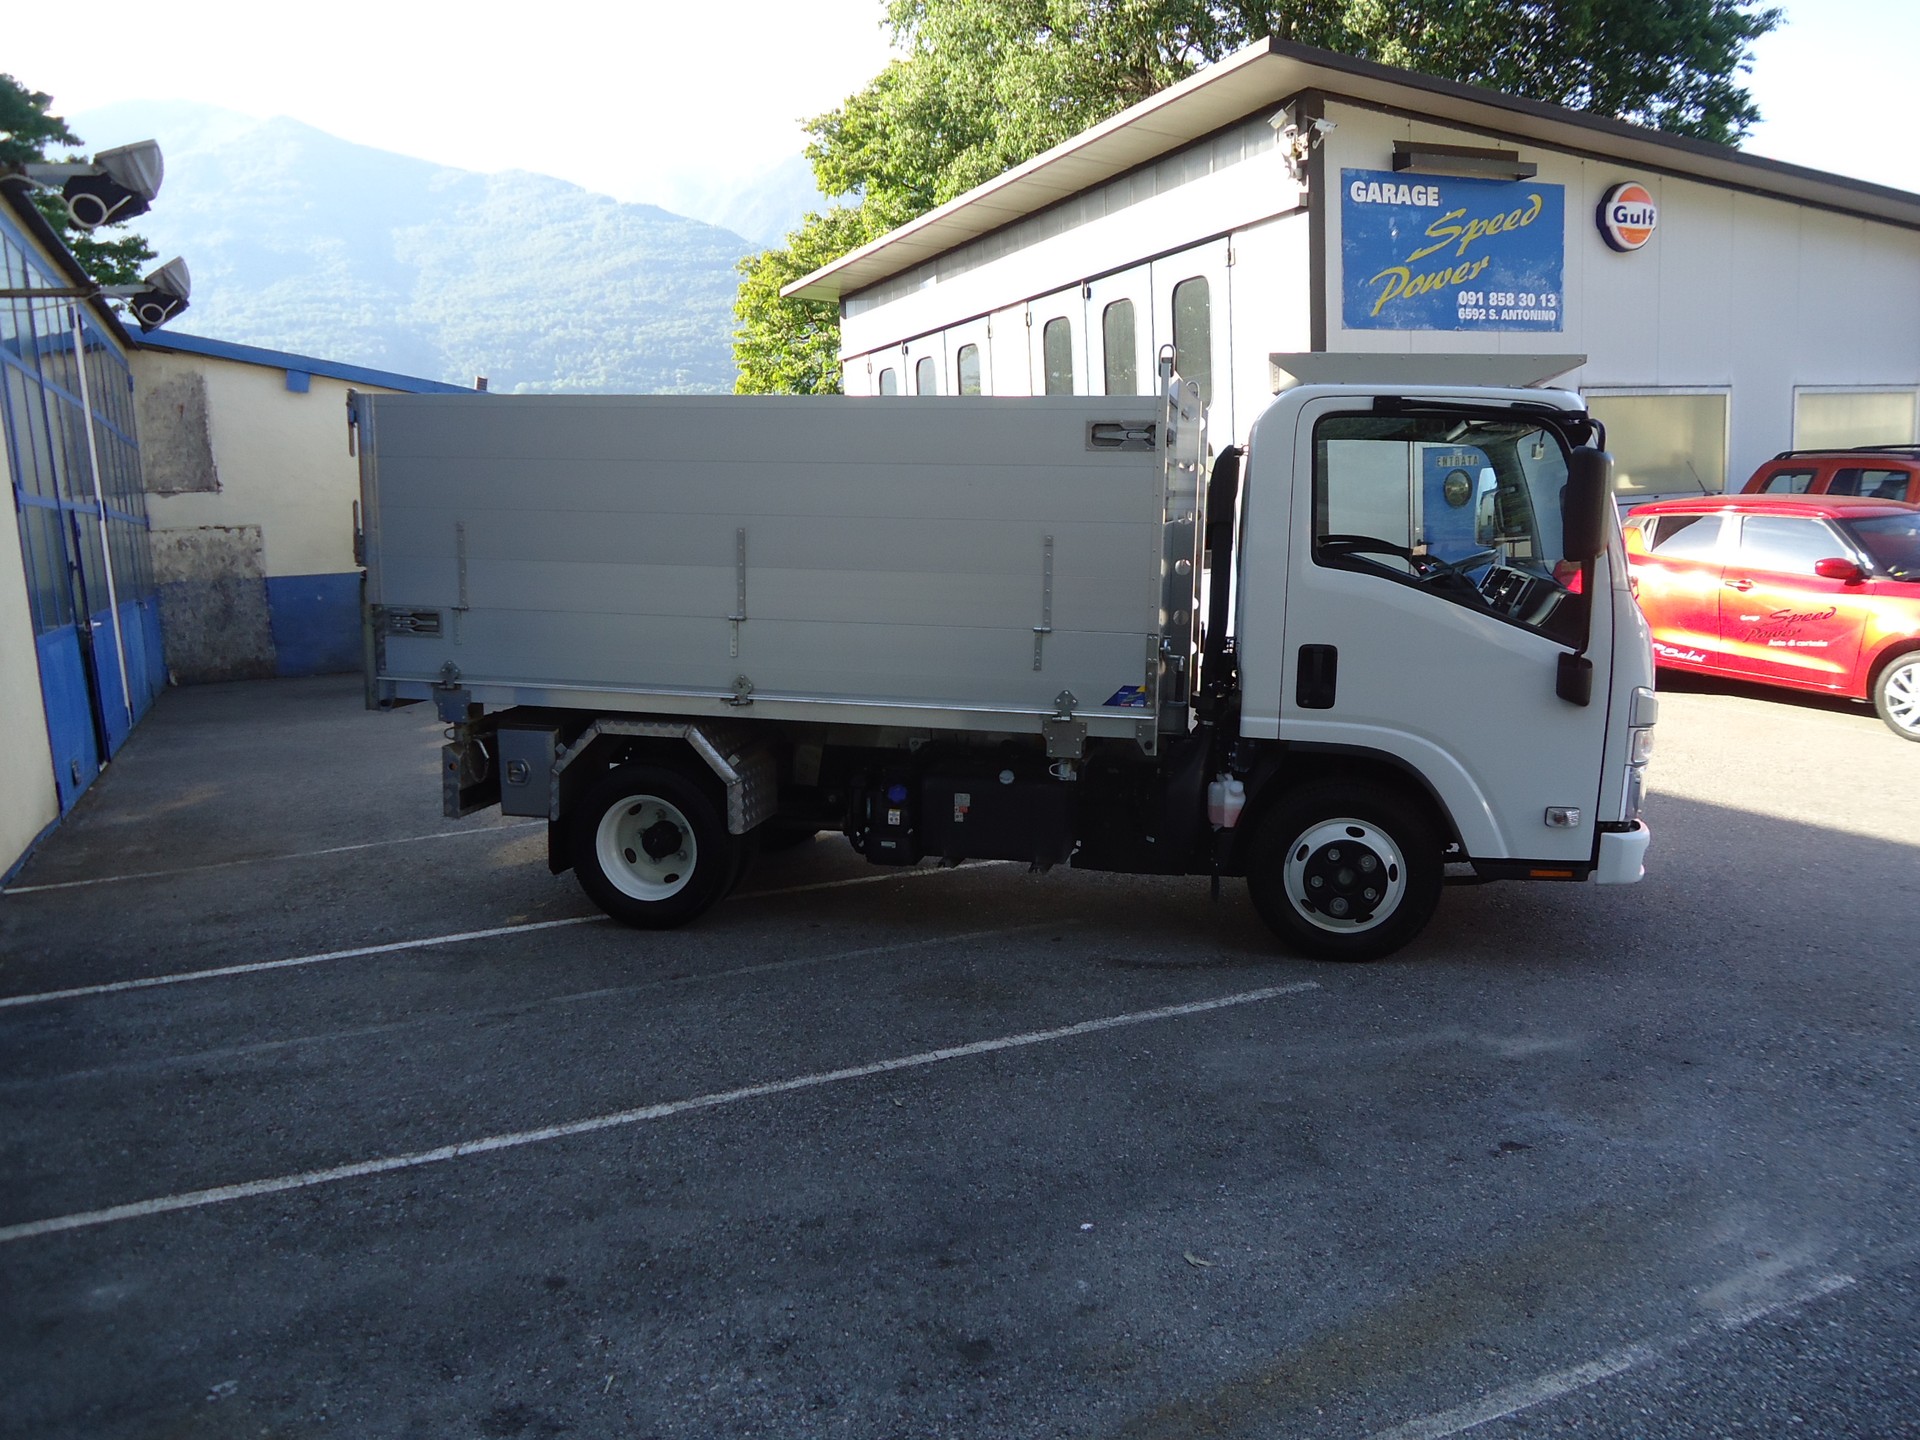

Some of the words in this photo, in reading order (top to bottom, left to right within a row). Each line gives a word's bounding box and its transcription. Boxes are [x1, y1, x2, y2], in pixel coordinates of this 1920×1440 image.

[1350, 181, 1439, 206] GARAGE
[1613, 205, 1655, 225] Gulf
[1405, 194, 1543, 262] Speed
[1369, 255, 1490, 317] Power
[1458, 291, 1484, 305] 091
[1489, 292, 1515, 306] 858
[1518, 293, 1535, 307] 30
[1540, 294, 1556, 307] 13
[1458, 308, 1486, 320] 6592
[1489, 308, 1499, 320] S.
[1501, 309, 1556, 320] ANTONINO
[1436, 455, 1479, 467] ENTRATA
[1761, 606, 1837, 628] Speed
